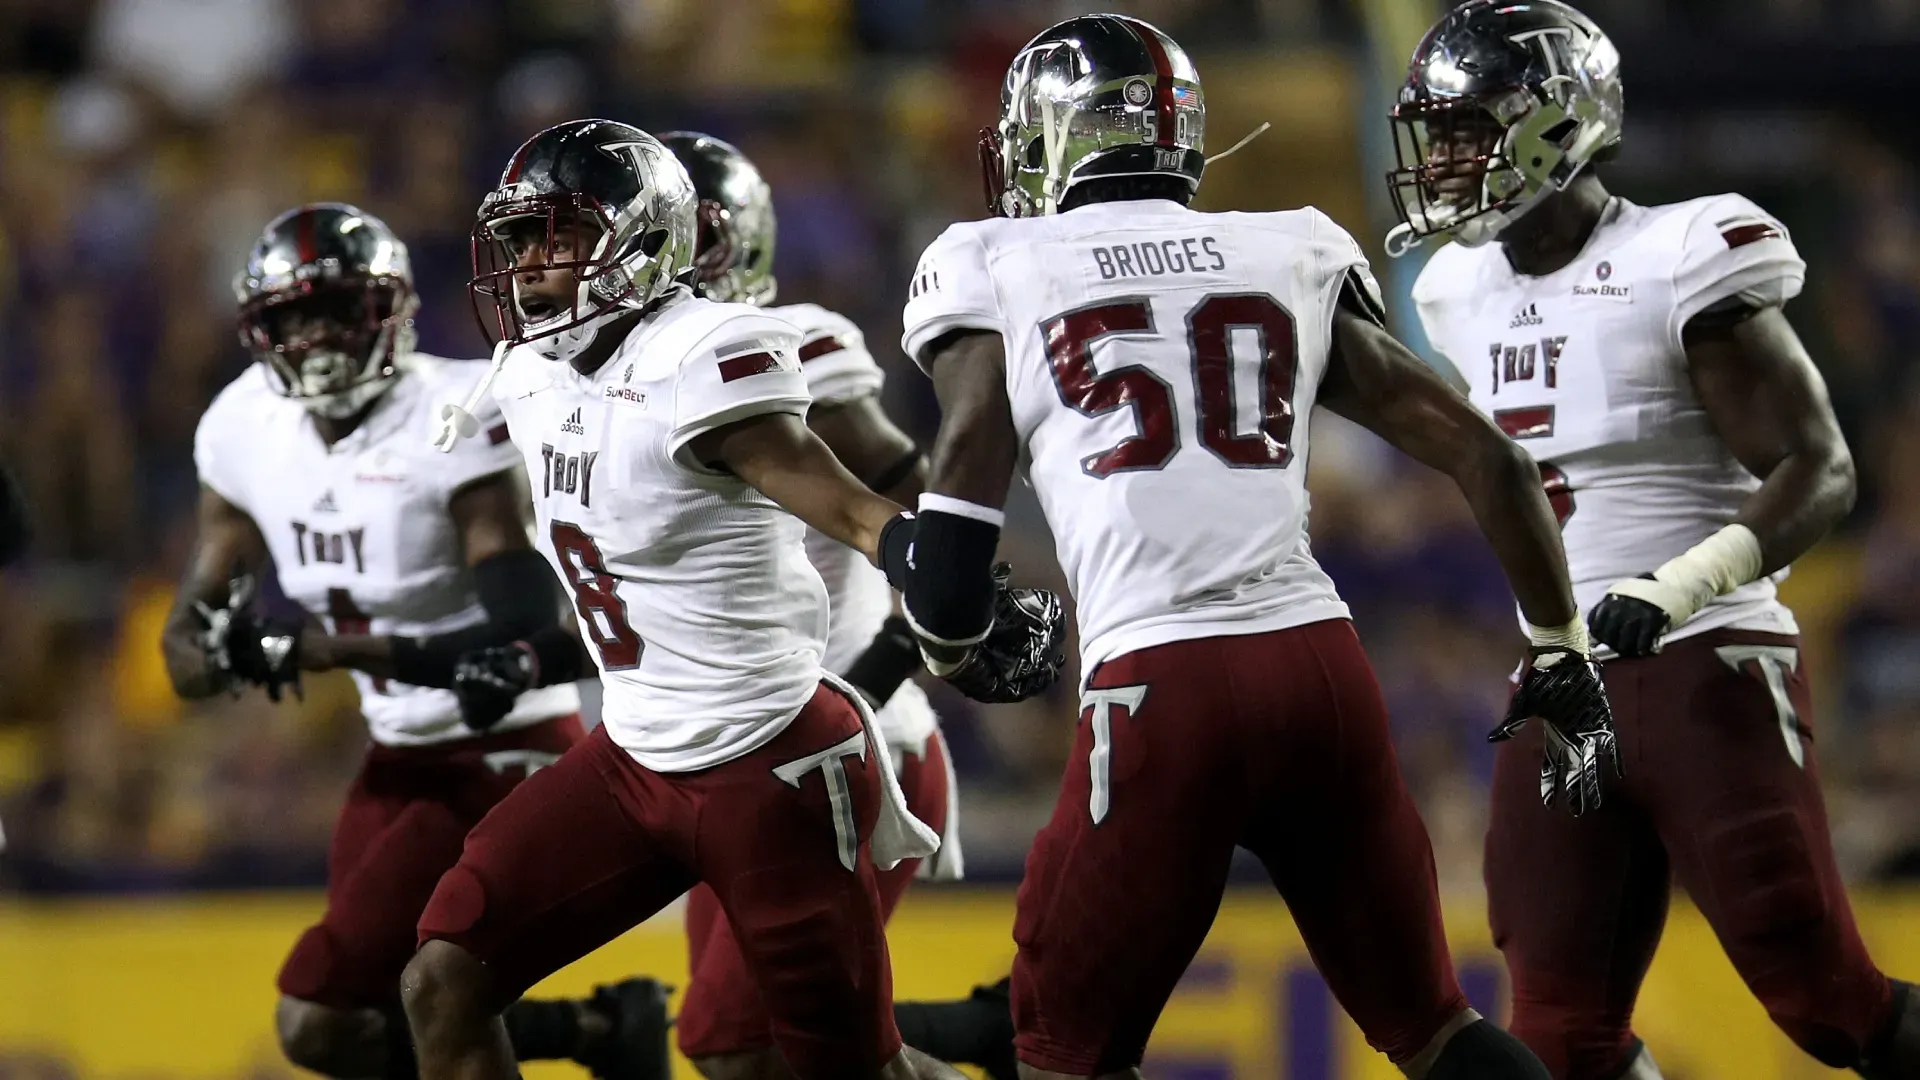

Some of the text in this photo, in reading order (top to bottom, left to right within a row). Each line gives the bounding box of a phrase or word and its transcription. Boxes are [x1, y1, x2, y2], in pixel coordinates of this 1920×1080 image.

[1153, 147, 1187, 172] TROY
[1092, 236, 1226, 280] BRIDGES
[1038, 291, 1299, 480] 50
[1489, 335, 1569, 395] TROY
[560, 423, 584, 436] adidas
[541, 442, 600, 509] TROY
[550, 518, 646, 672] 8
